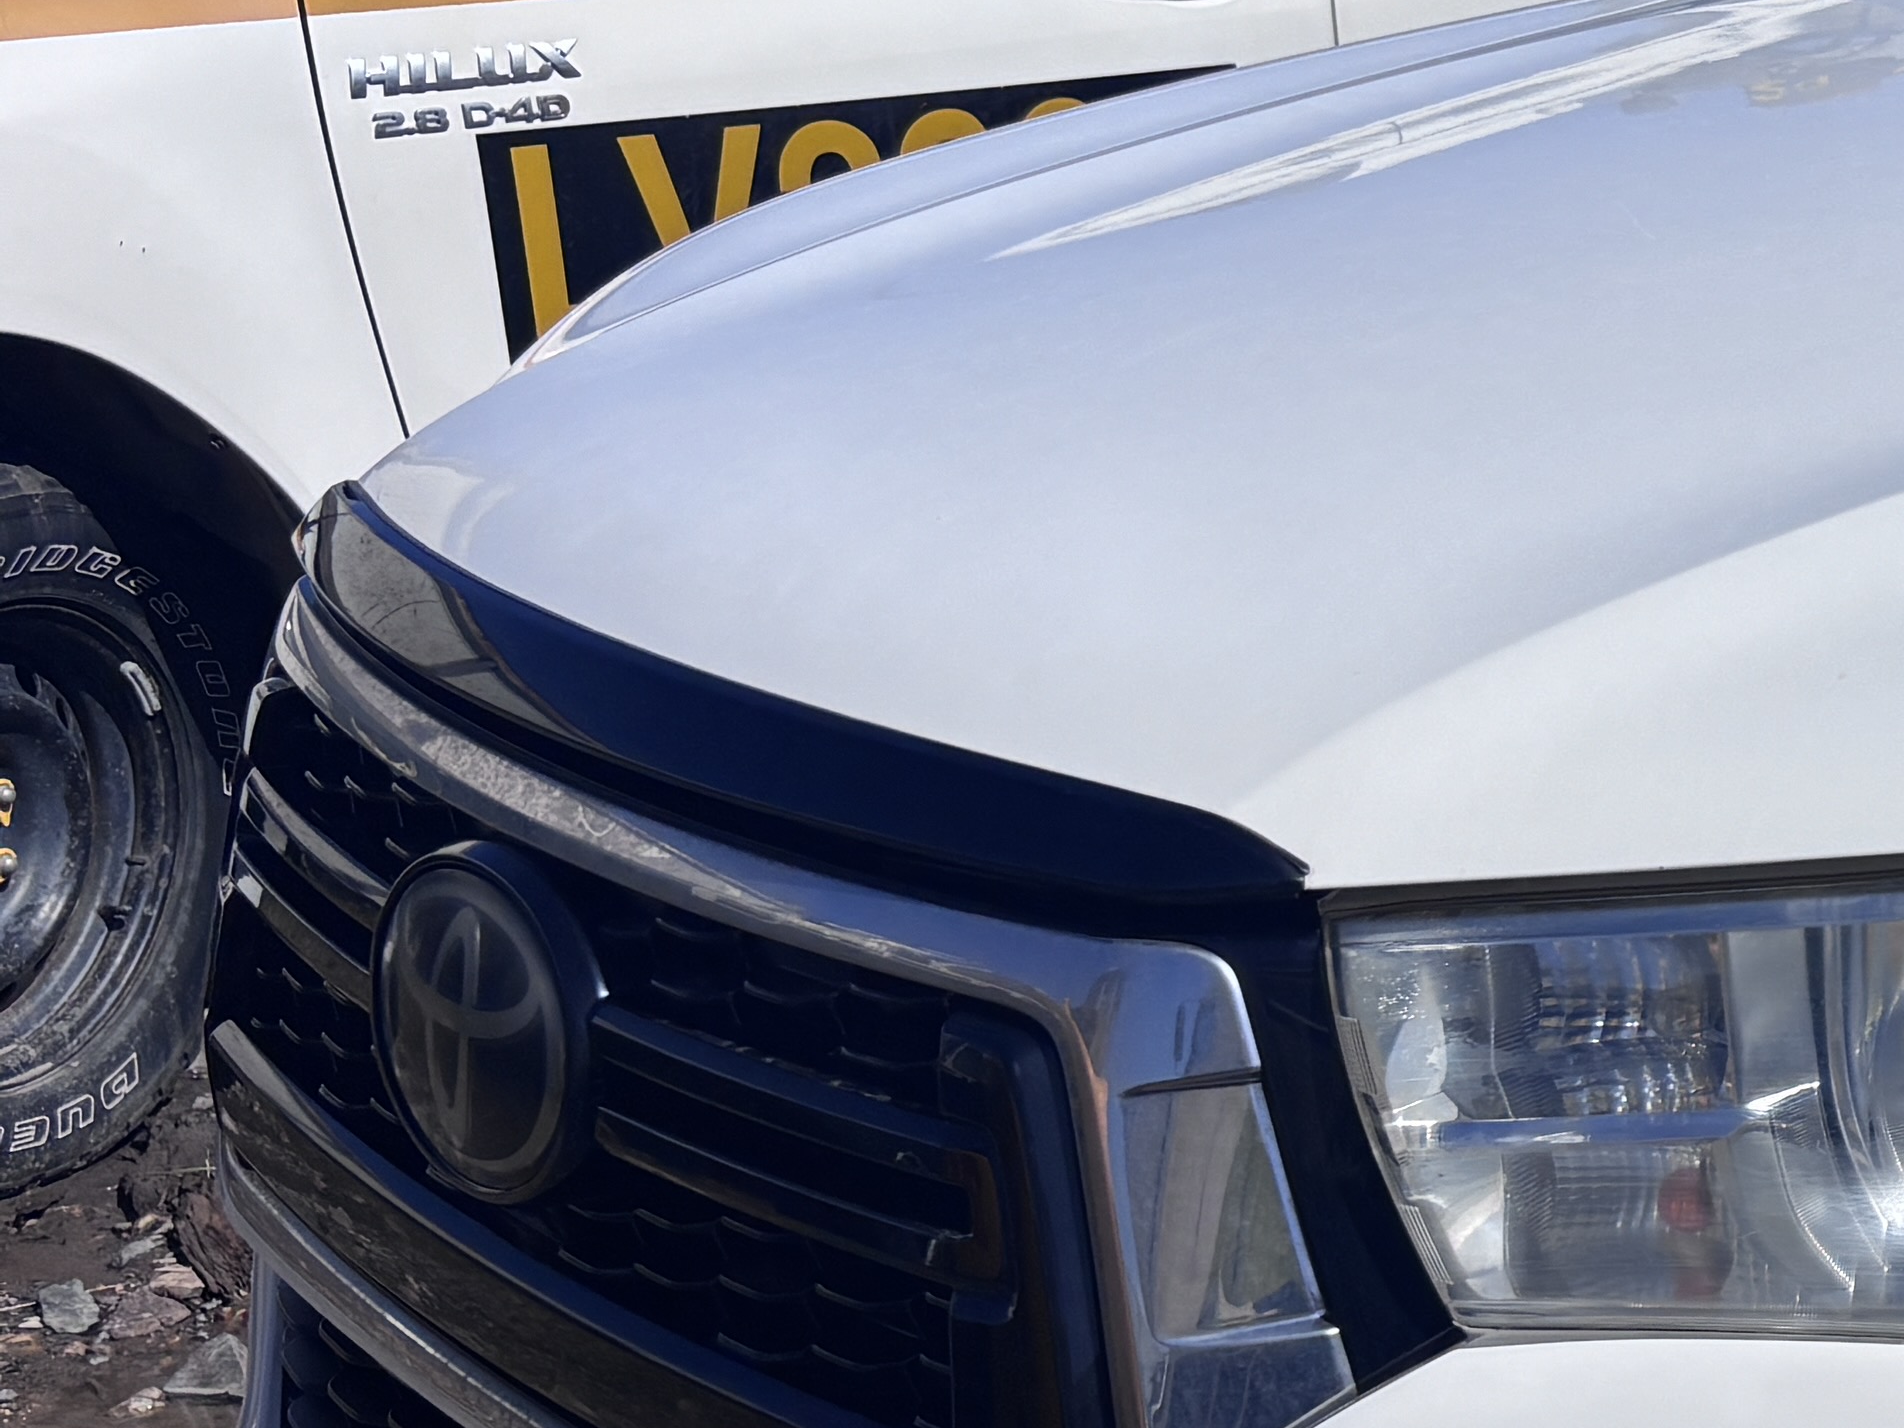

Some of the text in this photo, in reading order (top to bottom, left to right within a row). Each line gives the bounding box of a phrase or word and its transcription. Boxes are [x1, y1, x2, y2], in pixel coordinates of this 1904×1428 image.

[346, 37, 582, 100] HILUX
[461, 94, 571, 130] D-4D
[0, 1051, 140, 1153] DUE
